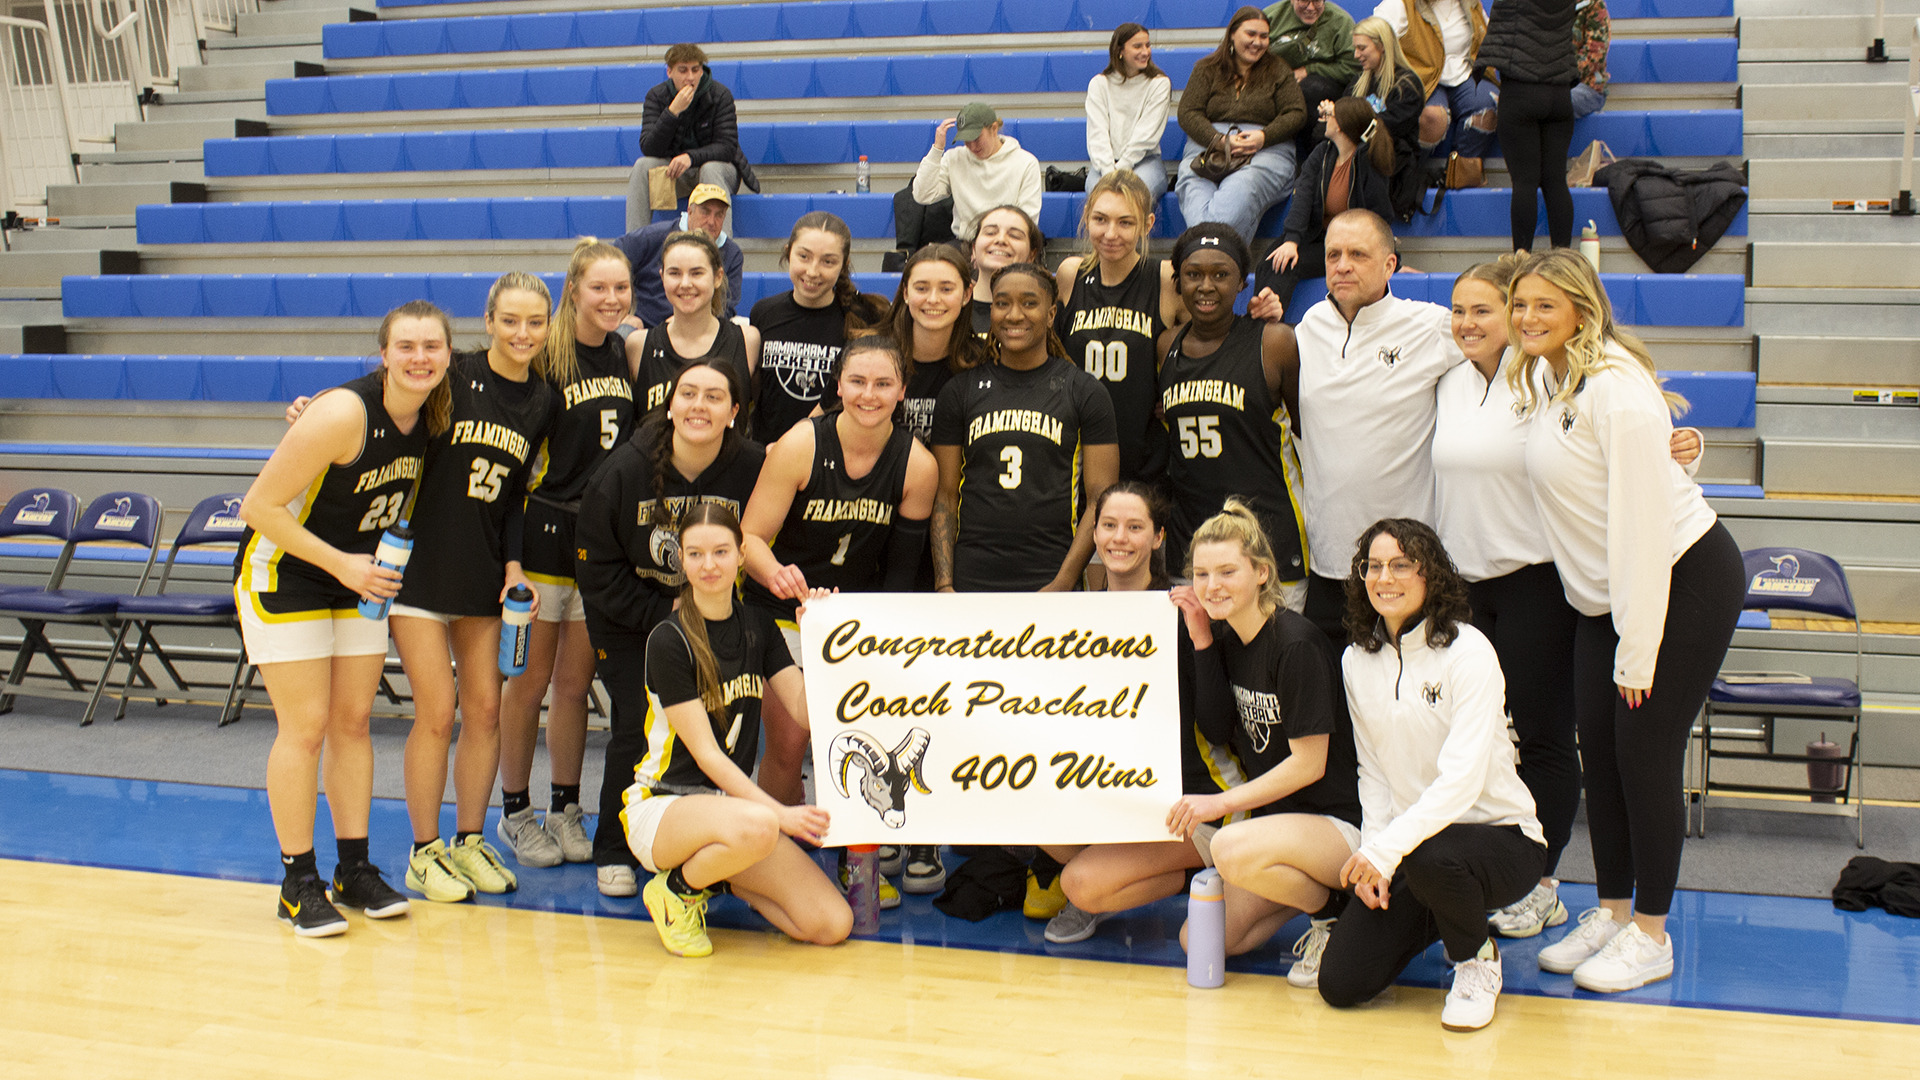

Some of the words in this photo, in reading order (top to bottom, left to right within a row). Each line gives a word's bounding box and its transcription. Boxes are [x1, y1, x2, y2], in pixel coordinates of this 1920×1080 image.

[762, 353, 832, 373] BASKETB
[764, 340, 827, 359] FRAMINGHAM
[1085, 340, 1128, 382] 00
[563, 375, 633, 411] FRAMINGHA
[1163, 379, 1245, 414] FRAMINGHAM
[450, 420, 530, 466] FRAMINGHA
[600, 409, 619, 450] 5
[968, 409, 1063, 446] FRAMINGHAM
[1177, 415, 1223, 459] 55
[353, 456, 421, 494] FRAMINGHA
[467, 456, 511, 503] 25
[999, 445, 1022, 490] 3
[358, 491, 405, 532] 23
[802, 497, 893, 526] FRAMINGHAM
[830, 533, 852, 566] 1
[515, 624, 528, 666] OWERADE
[822, 619, 1157, 668] Congratulations
[836, 680, 951, 723] Coach
[965, 681, 1149, 719] Paschal!
[951, 754, 1037, 791] 400
[1050, 752, 1158, 790] Wins
